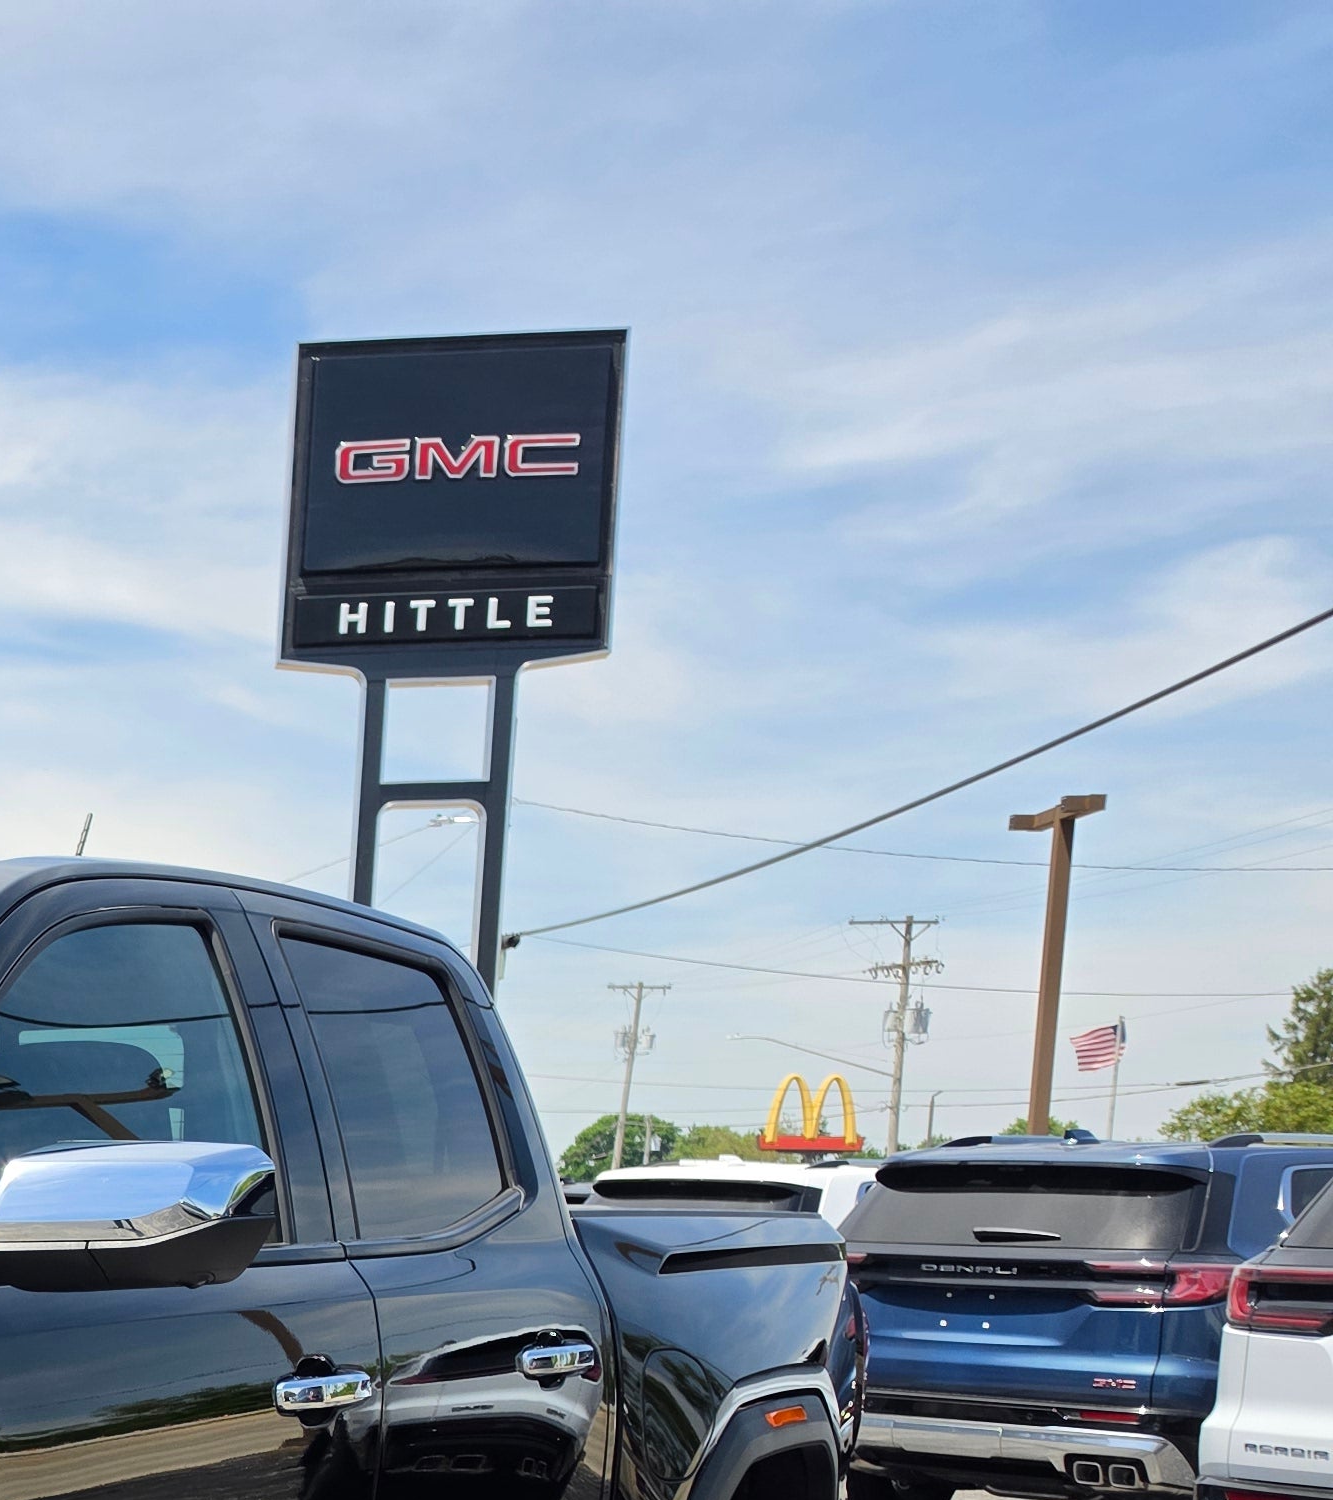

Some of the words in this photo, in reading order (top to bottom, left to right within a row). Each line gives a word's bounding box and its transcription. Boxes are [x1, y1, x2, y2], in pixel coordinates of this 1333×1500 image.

[335, 432, 582, 485] GMC
[337, 594, 555, 636] HITTLE
[920, 1262, 1018, 1276] DENALI
[1244, 1442, 1330, 1462] ACADIA
